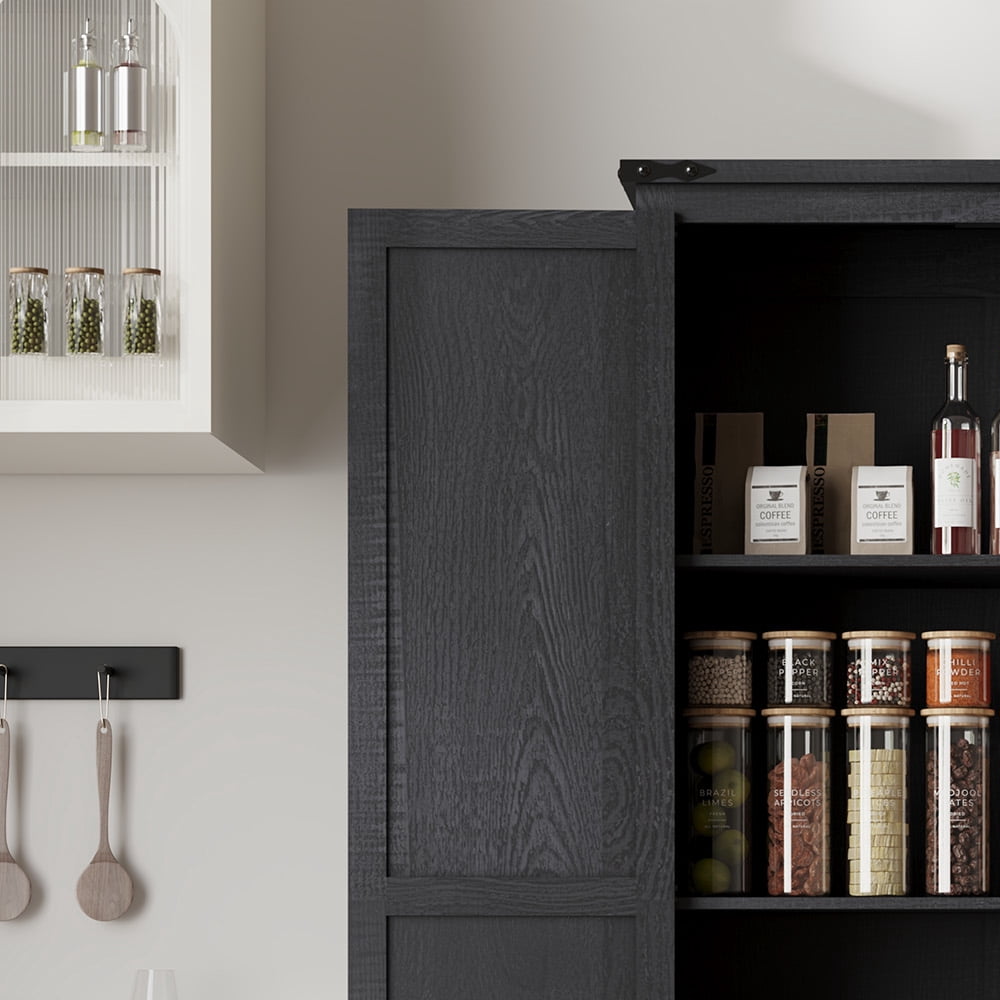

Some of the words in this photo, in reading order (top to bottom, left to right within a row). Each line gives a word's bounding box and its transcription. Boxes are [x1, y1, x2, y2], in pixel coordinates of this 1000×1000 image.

[759, 511, 791, 520] COFFEE
[866, 511, 898, 520] COFFEE
[782, 658, 815, 666] BACK
[948, 658, 976, 666] HILLI
[779, 668, 819, 676] PPPER
[936, 668, 981, 676] PWDER
[699, 788, 737, 797] BRAZIL
[774, 789, 823, 797] SEDLESS
[934, 789, 982, 797] MDJOOL
[702, 799, 734, 807] LIMES
[774, 799, 822, 807] APICOTS
[949, 799, 974, 807] ATES
